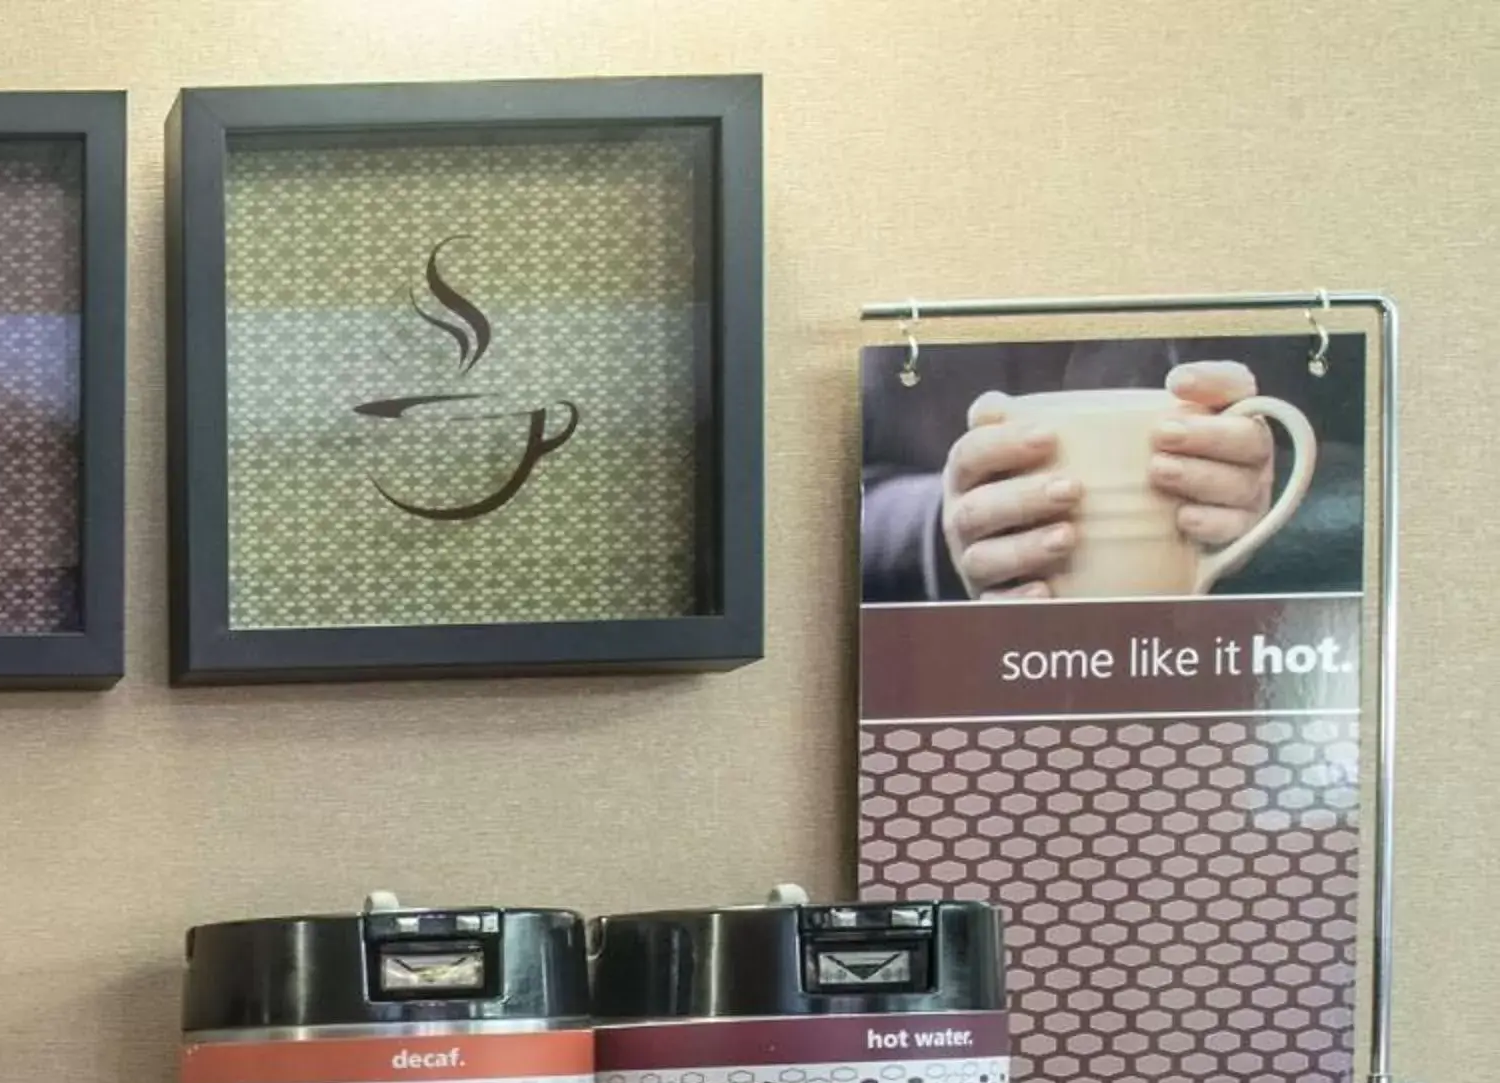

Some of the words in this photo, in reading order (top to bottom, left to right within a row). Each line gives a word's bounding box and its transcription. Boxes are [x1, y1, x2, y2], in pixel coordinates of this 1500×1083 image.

[1002, 649, 1114, 681] some
[1130, 637, 1199, 677] like
[1215, 636, 1241, 676] it
[1253, 635, 1353, 675] hot.
[867, 1028, 908, 1049] hot
[914, 1027, 973, 1048] water.
[391, 1047, 466, 1069] decaf.
